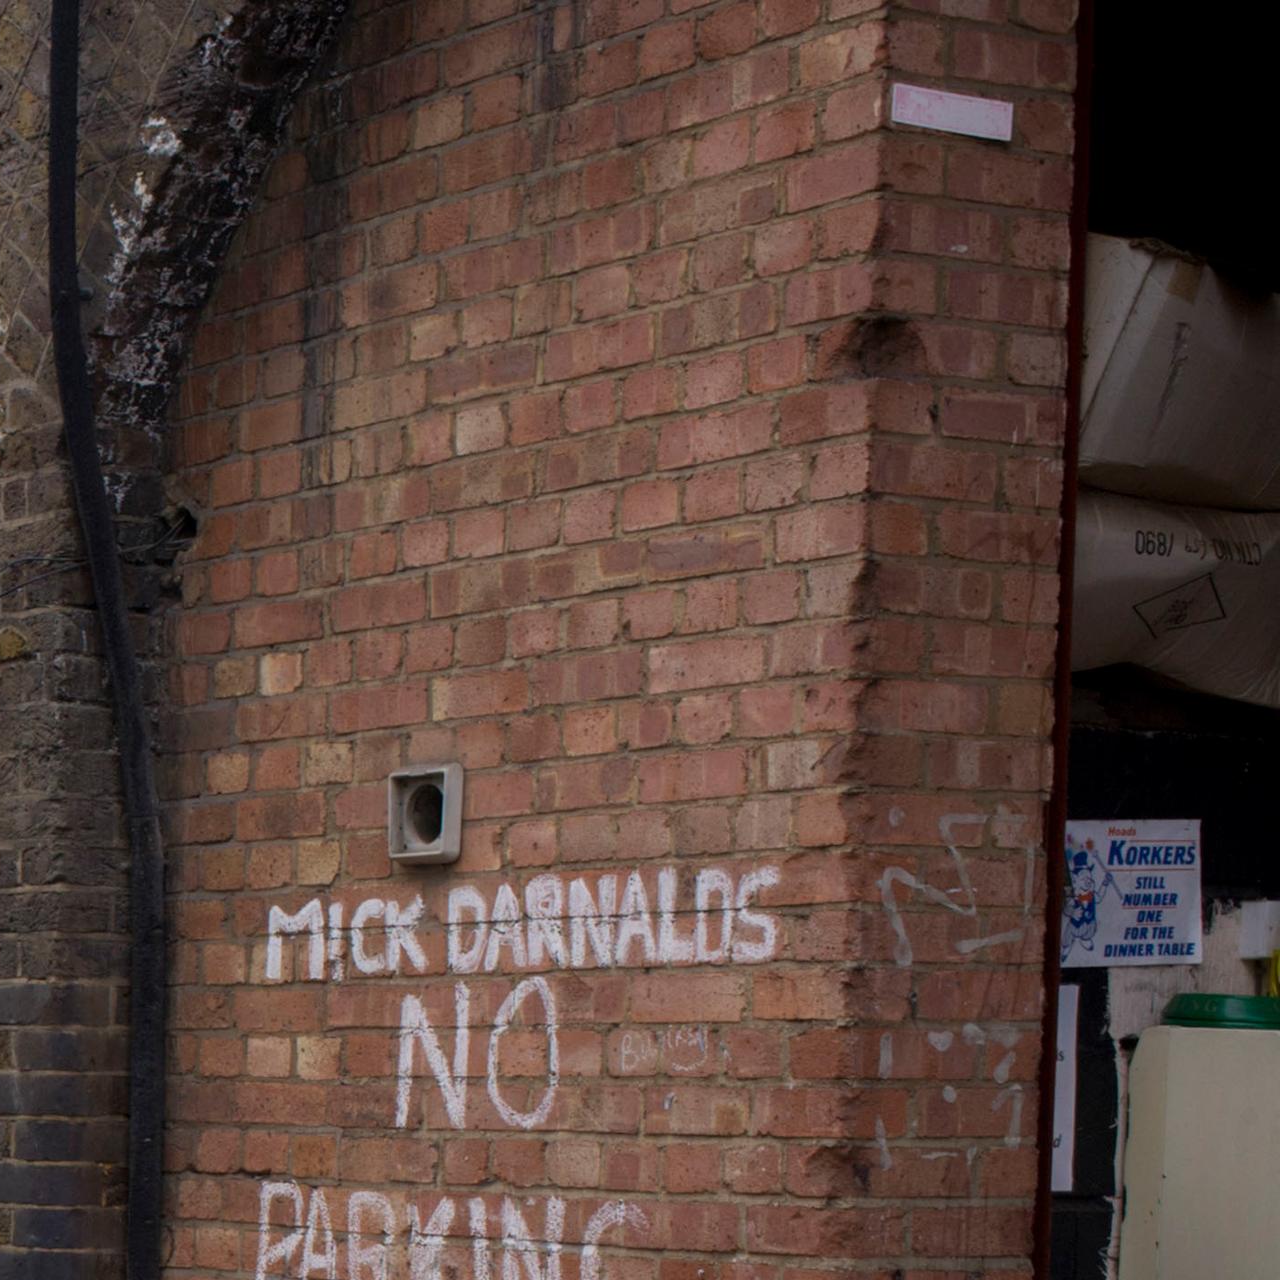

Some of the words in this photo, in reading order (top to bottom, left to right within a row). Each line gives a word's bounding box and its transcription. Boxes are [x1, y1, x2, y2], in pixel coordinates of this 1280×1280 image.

[1108, 840, 1196, 866] KORKERS
[1135, 876, 1166, 889] STILL
[1122, 893, 1179, 906] NUMBER
[266, 893, 430, 981] MICK
[447, 865, 782, 974] DARNALDS
[1137, 910, 1164, 923] ONE
[1124, 927, 1150, 940] FOR
[1152, 926, 1175, 939] THE
[1104, 944, 1154, 957] DINNER
[1158, 942, 1196, 956] TABLE
[396, 976, 559, 1130] NO
